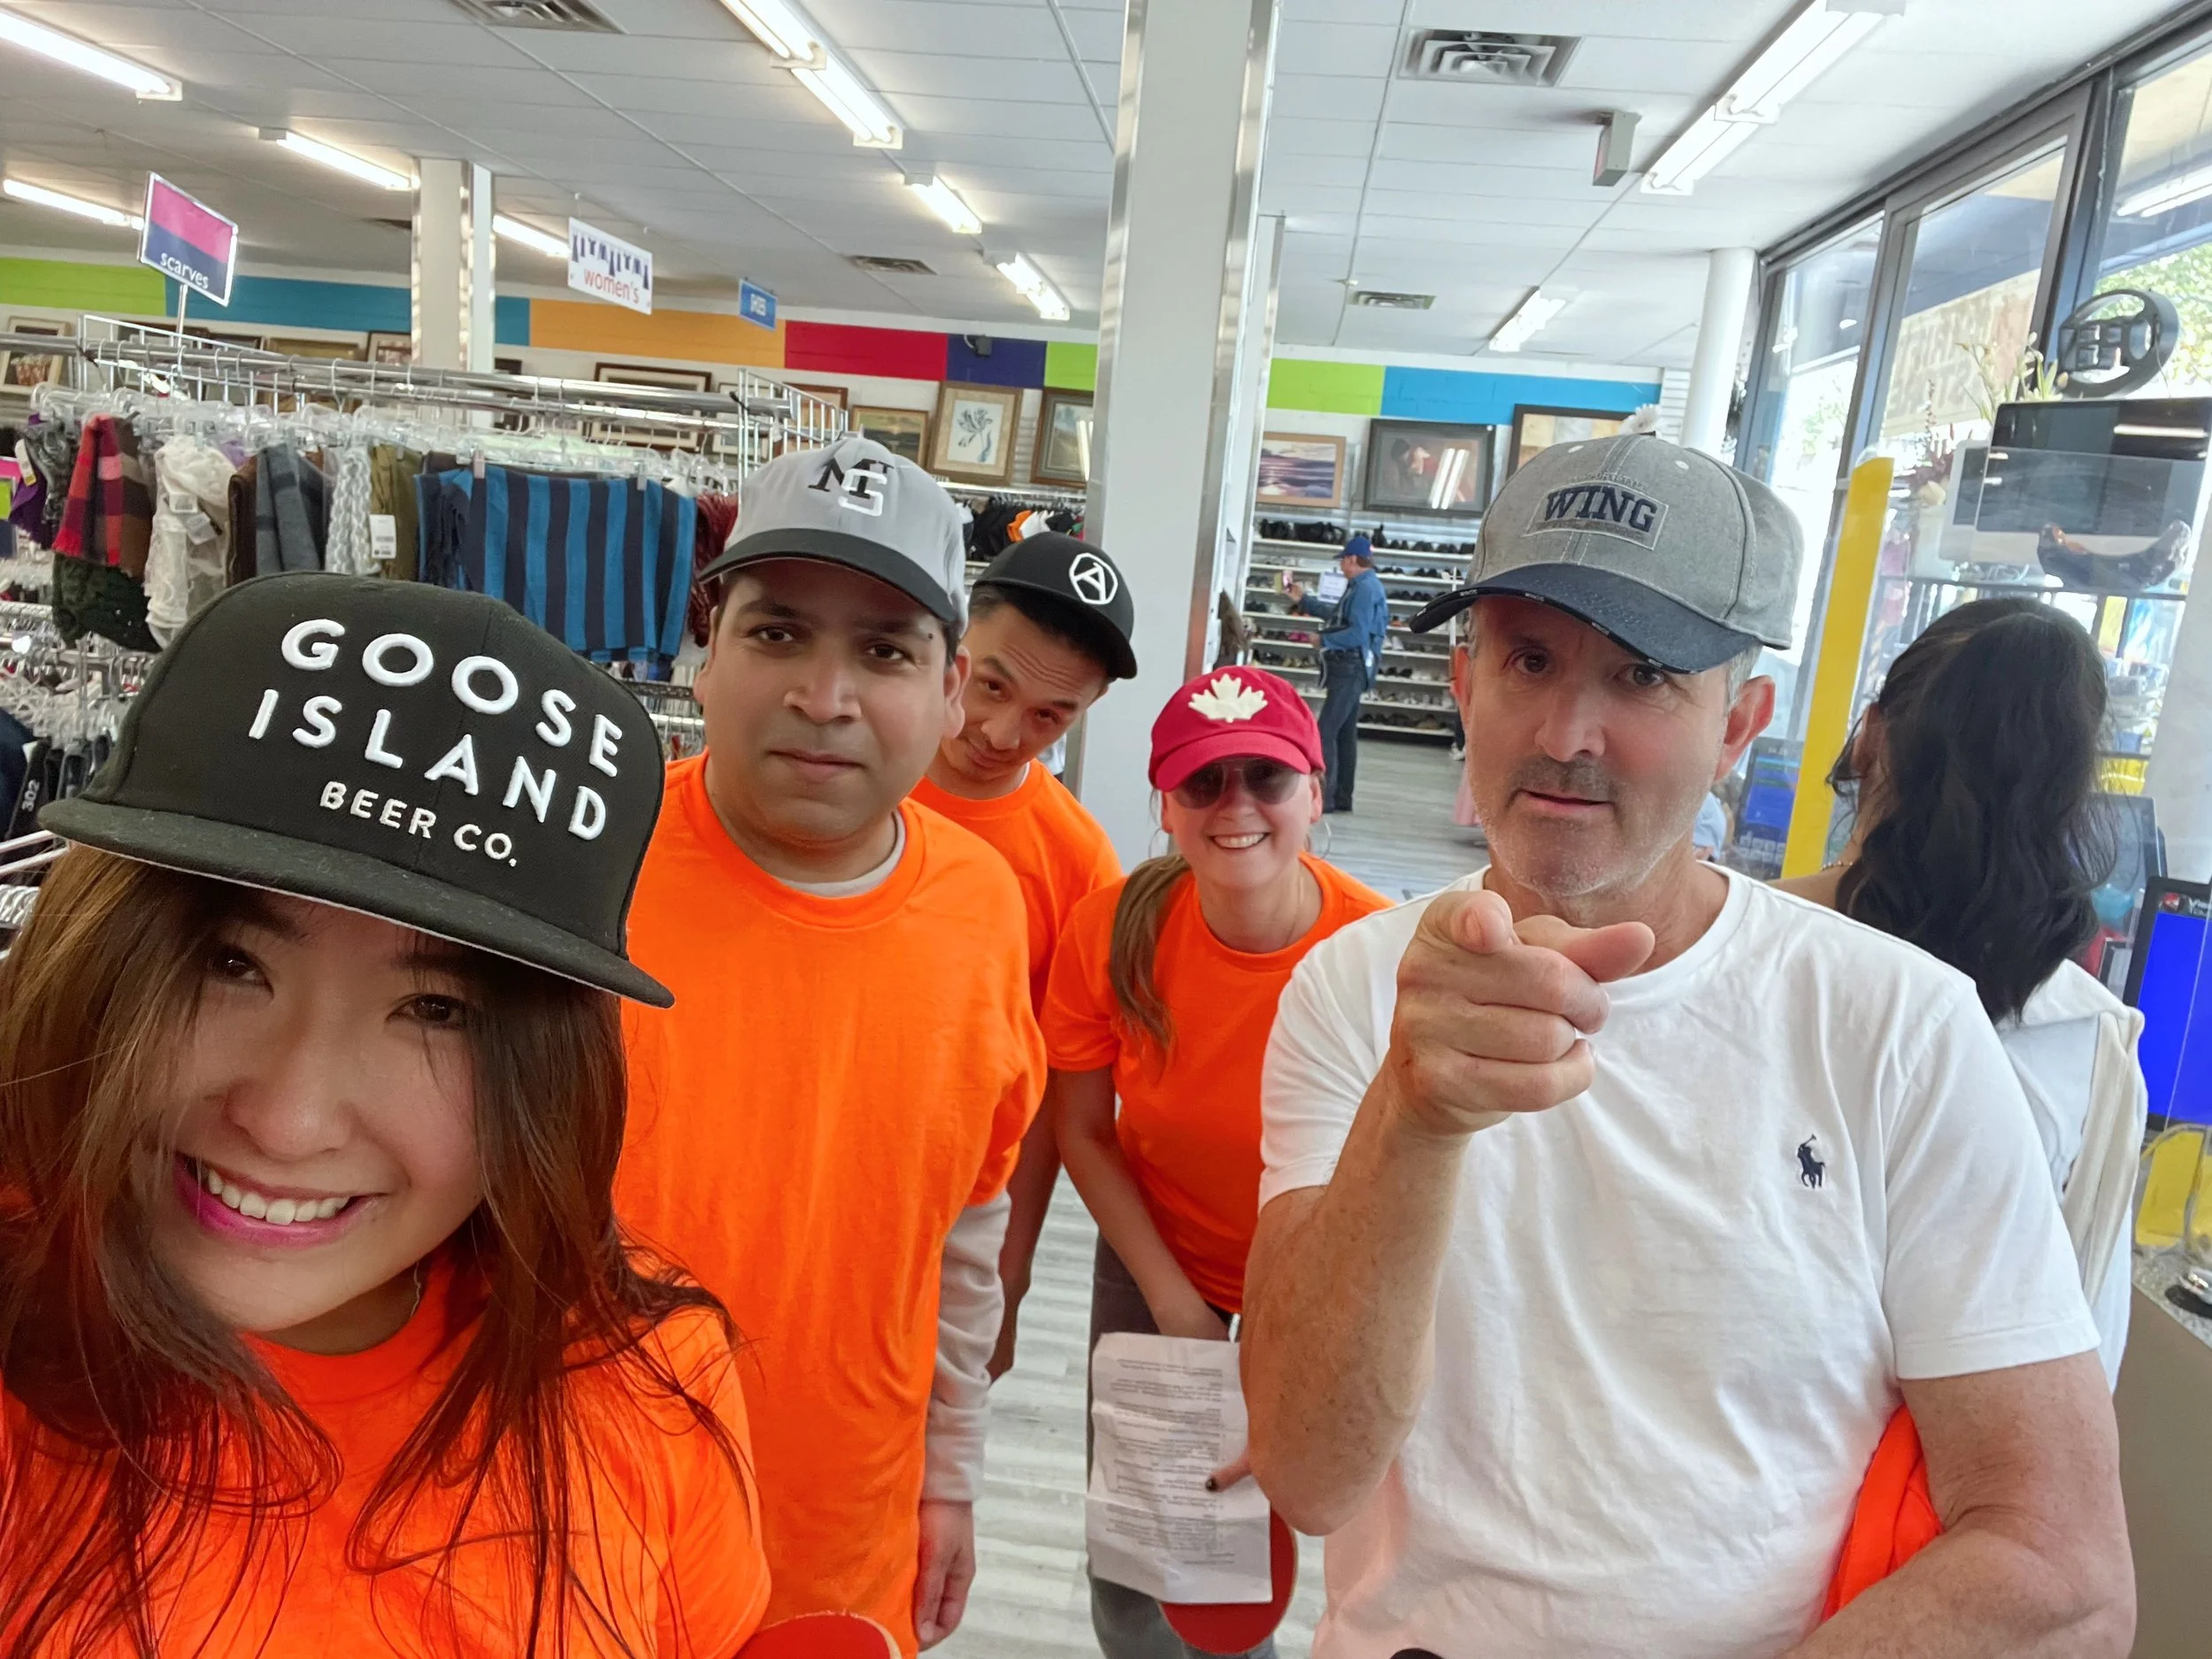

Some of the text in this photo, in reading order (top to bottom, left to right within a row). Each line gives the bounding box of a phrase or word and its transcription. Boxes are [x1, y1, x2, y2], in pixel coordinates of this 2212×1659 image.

[159, 252, 209, 289] scarves
[583, 268, 640, 305] women's
[1545, 486, 1657, 533] WING
[281, 618, 622, 777] GOOSE
[249, 688, 606, 841] ISLAND
[319, 780, 518, 867] BEER CO.
